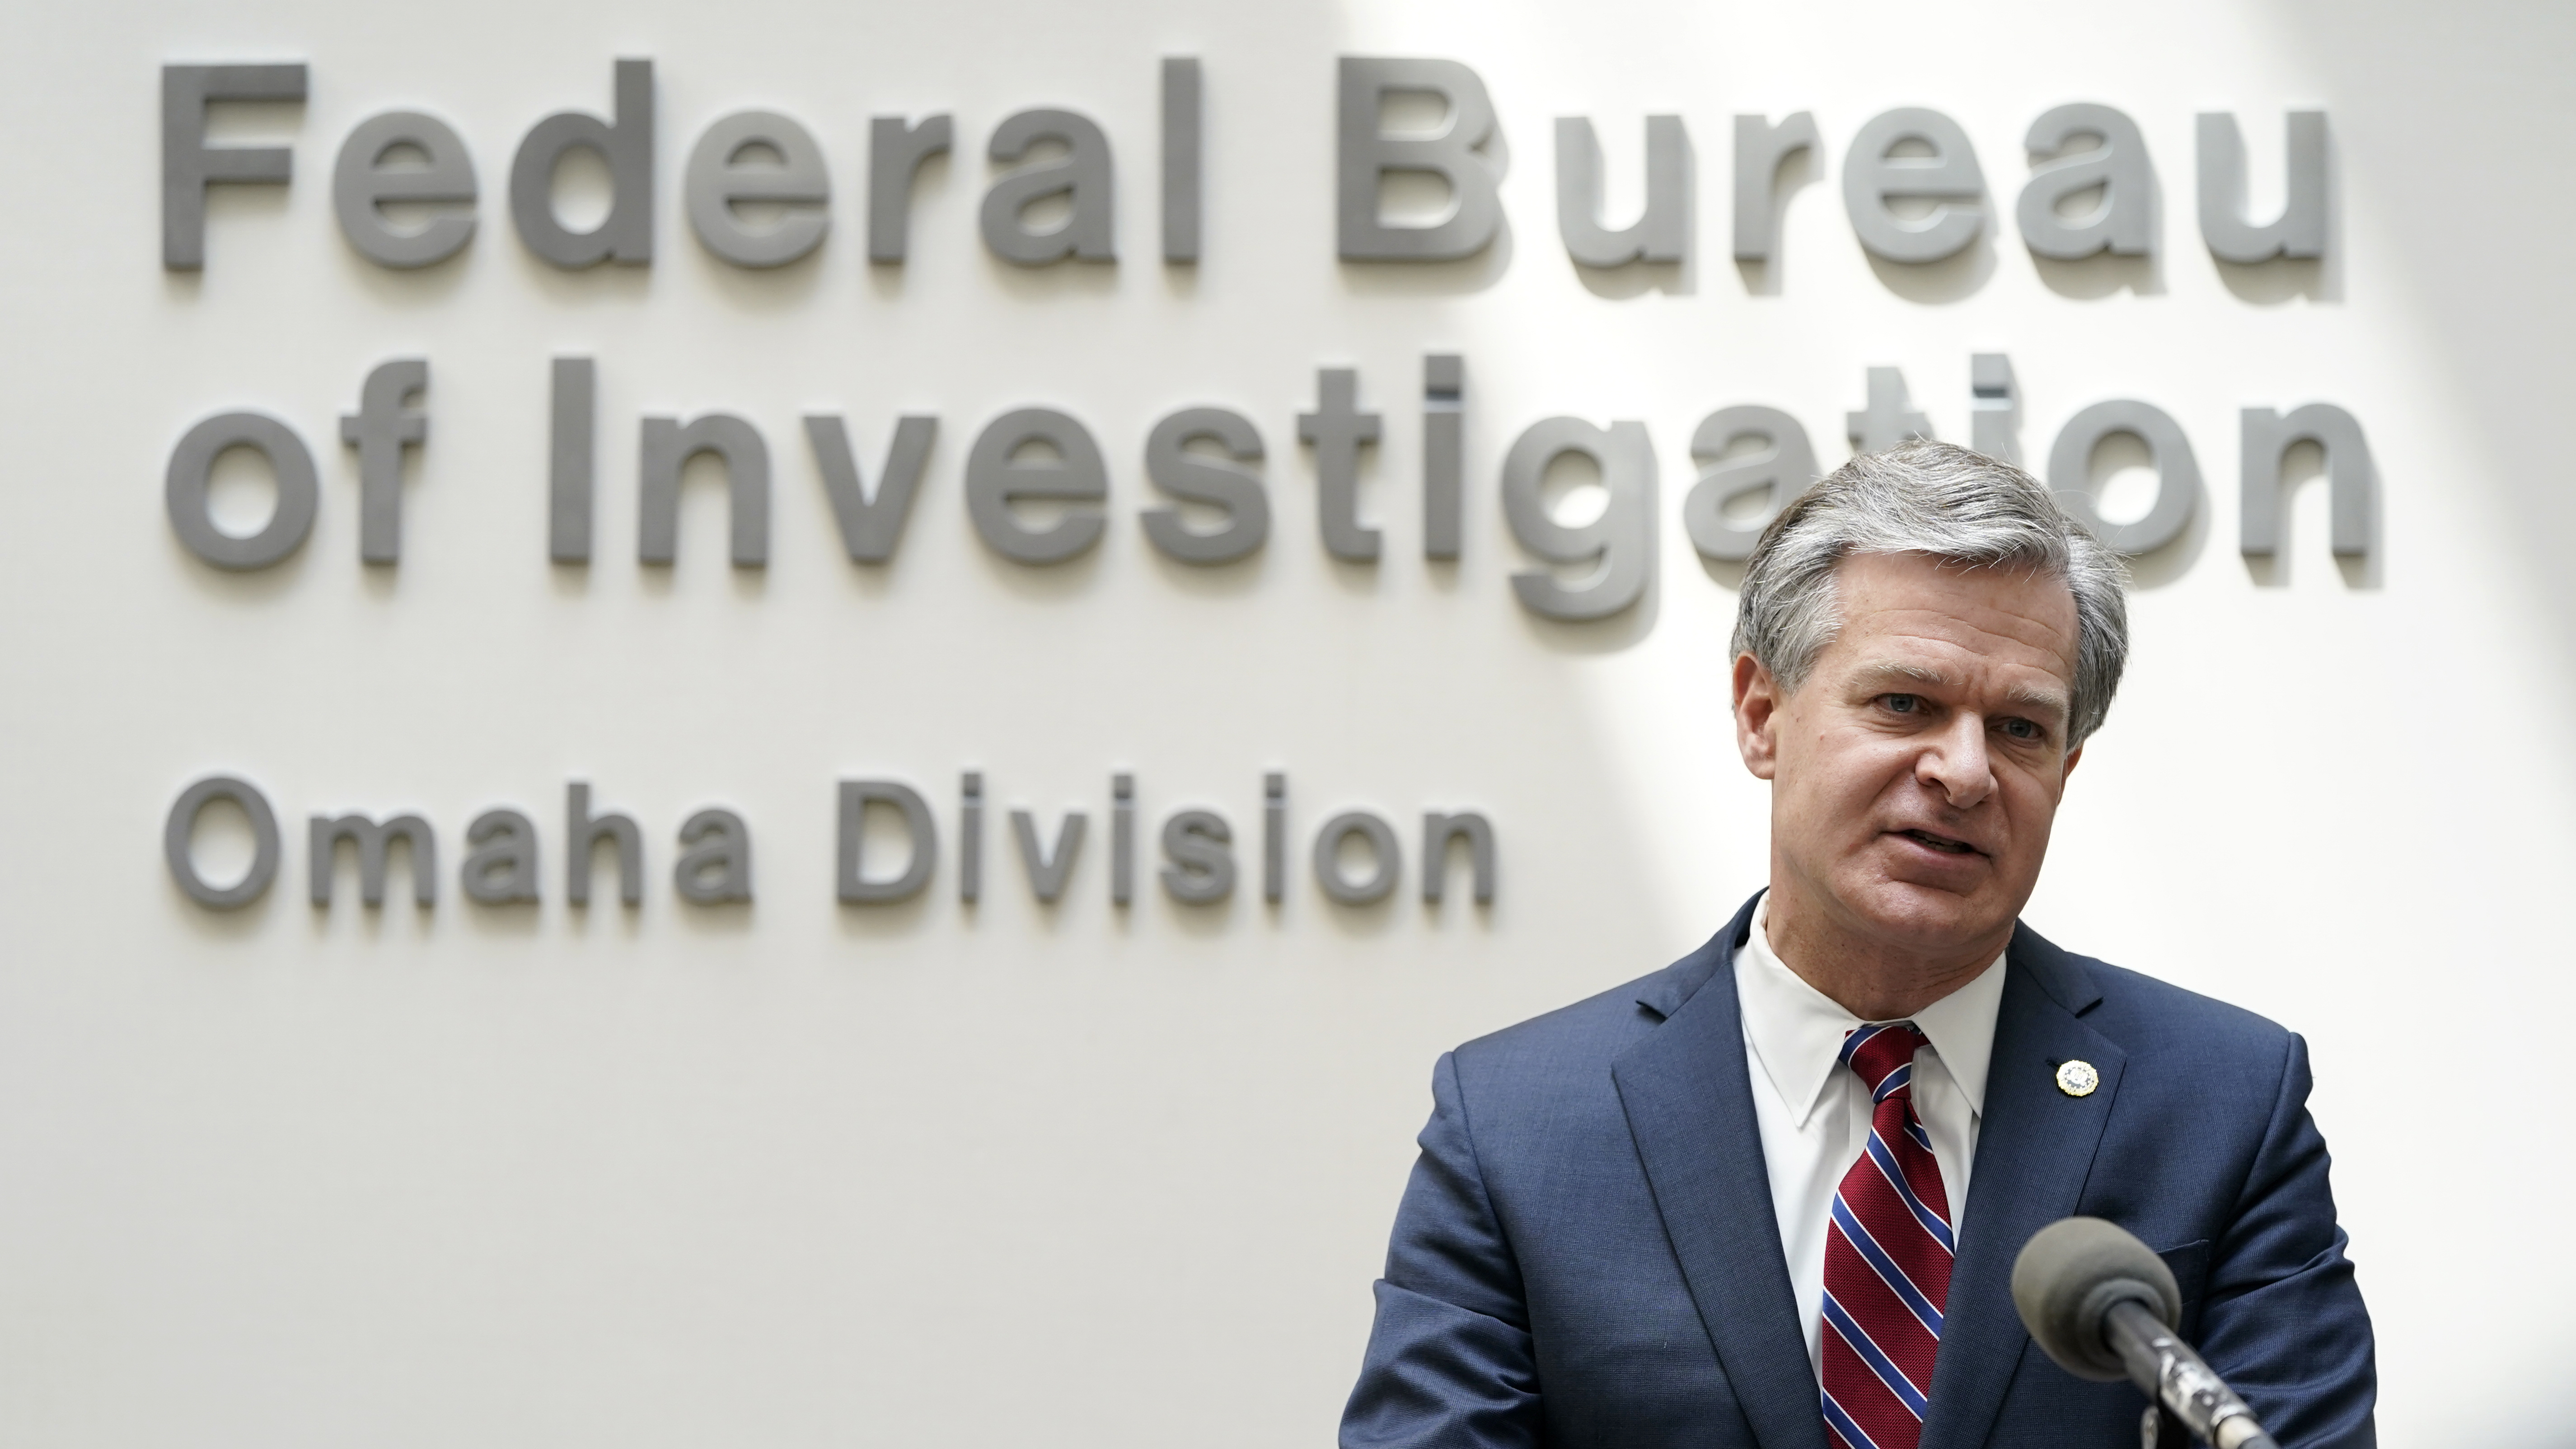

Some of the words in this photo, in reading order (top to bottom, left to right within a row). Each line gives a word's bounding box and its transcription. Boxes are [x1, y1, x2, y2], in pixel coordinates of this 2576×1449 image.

[162, 59, 1200, 277] Federal
[1337, 57, 2326, 272] Bureau
[165, 356, 427, 570] of
[165, 776, 754, 912] Omaha
[836, 773, 1495, 910] Division
